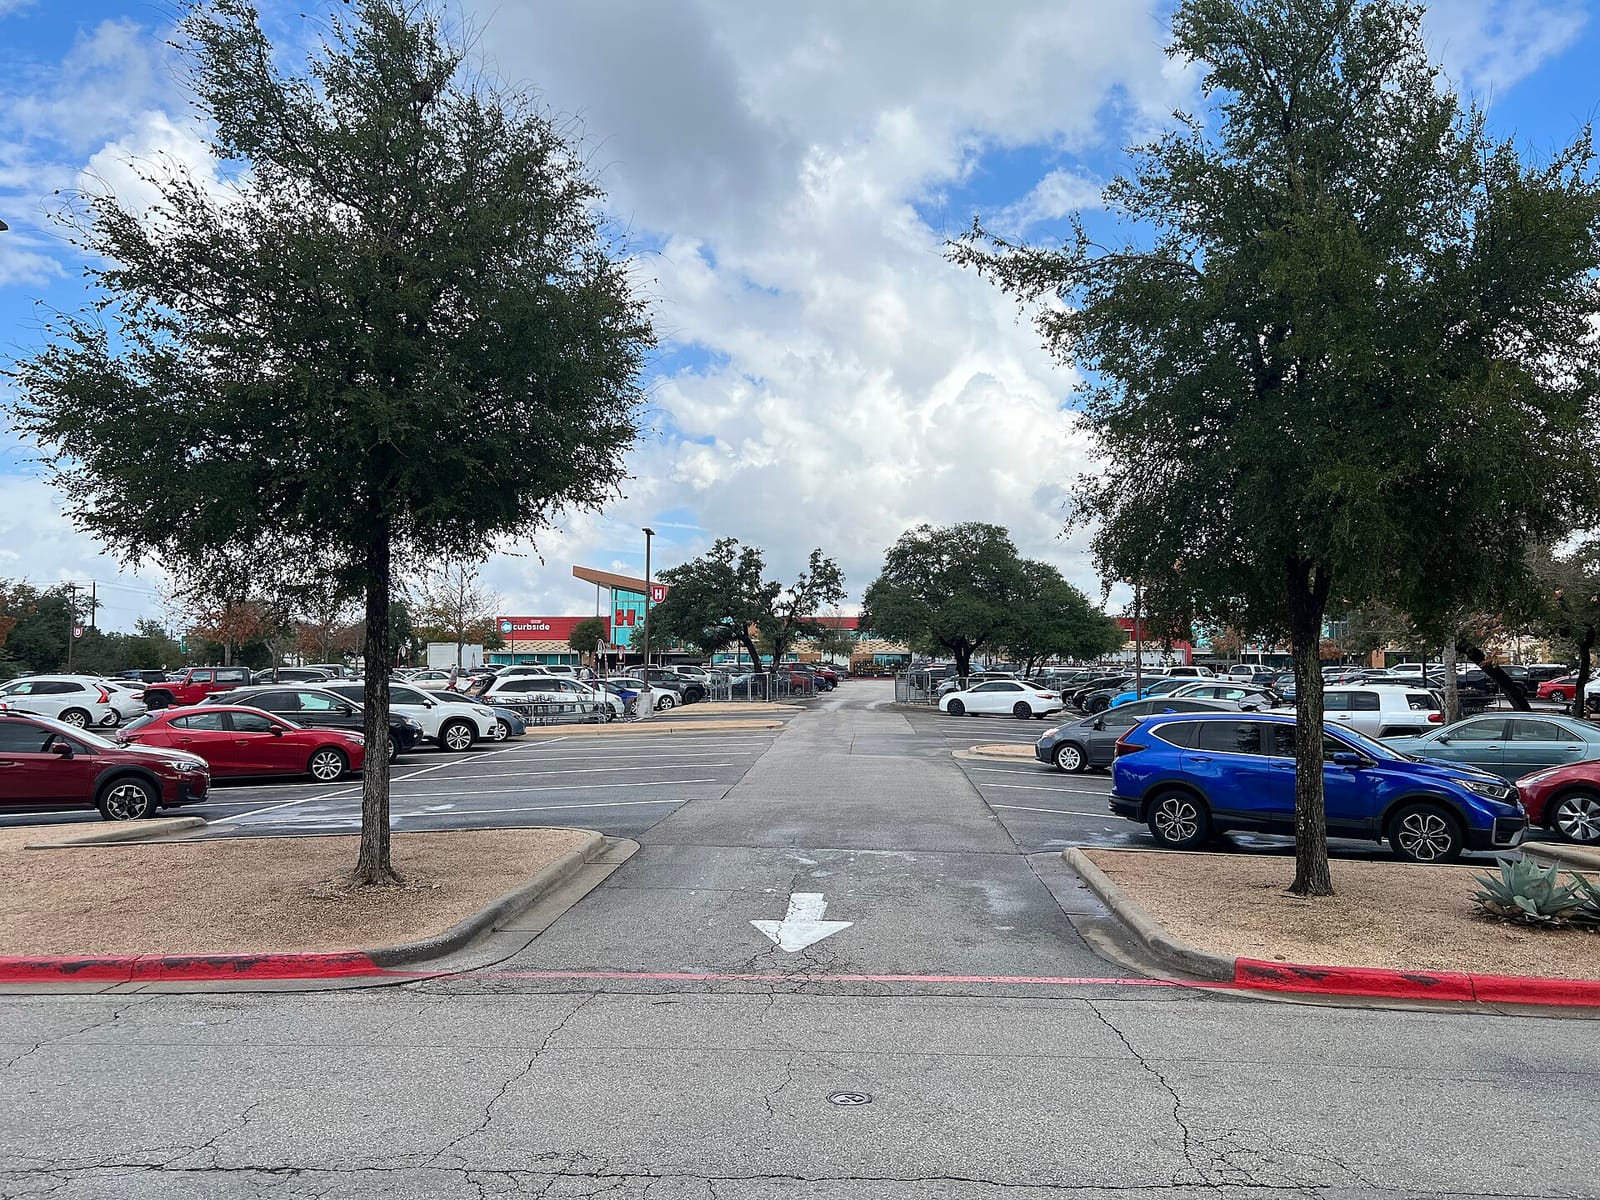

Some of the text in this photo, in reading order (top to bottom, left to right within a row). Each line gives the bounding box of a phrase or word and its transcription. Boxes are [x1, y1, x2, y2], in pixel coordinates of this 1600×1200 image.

[654, 588, 663, 600] H
[615, 609, 649, 627] H-
[512, 623, 551, 631] curbside
